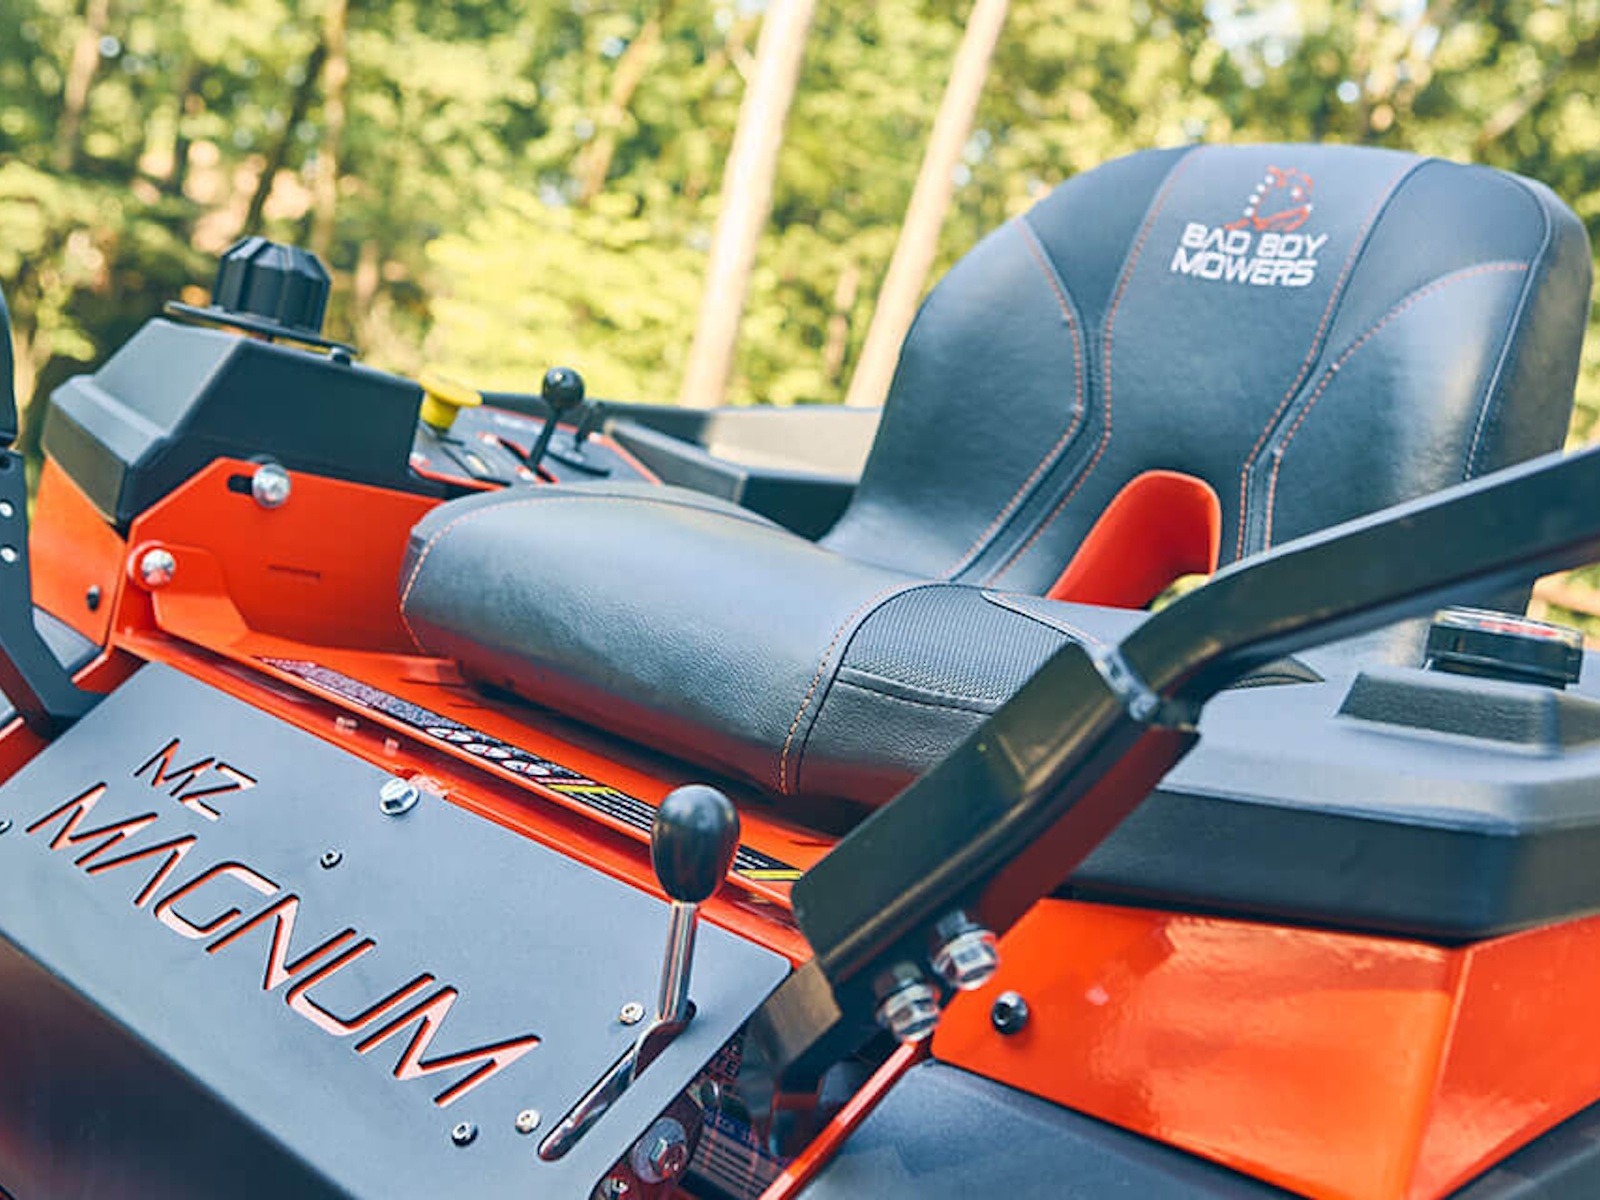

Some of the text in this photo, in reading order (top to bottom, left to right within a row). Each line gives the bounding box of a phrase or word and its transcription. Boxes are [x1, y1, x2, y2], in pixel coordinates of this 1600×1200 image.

[1170, 247, 1318, 286] MOWERS
[1182, 222, 1328, 258] BAD BOY
[134, 738, 257, 821] MZ
[26, 782, 542, 1107] MAGNUM
